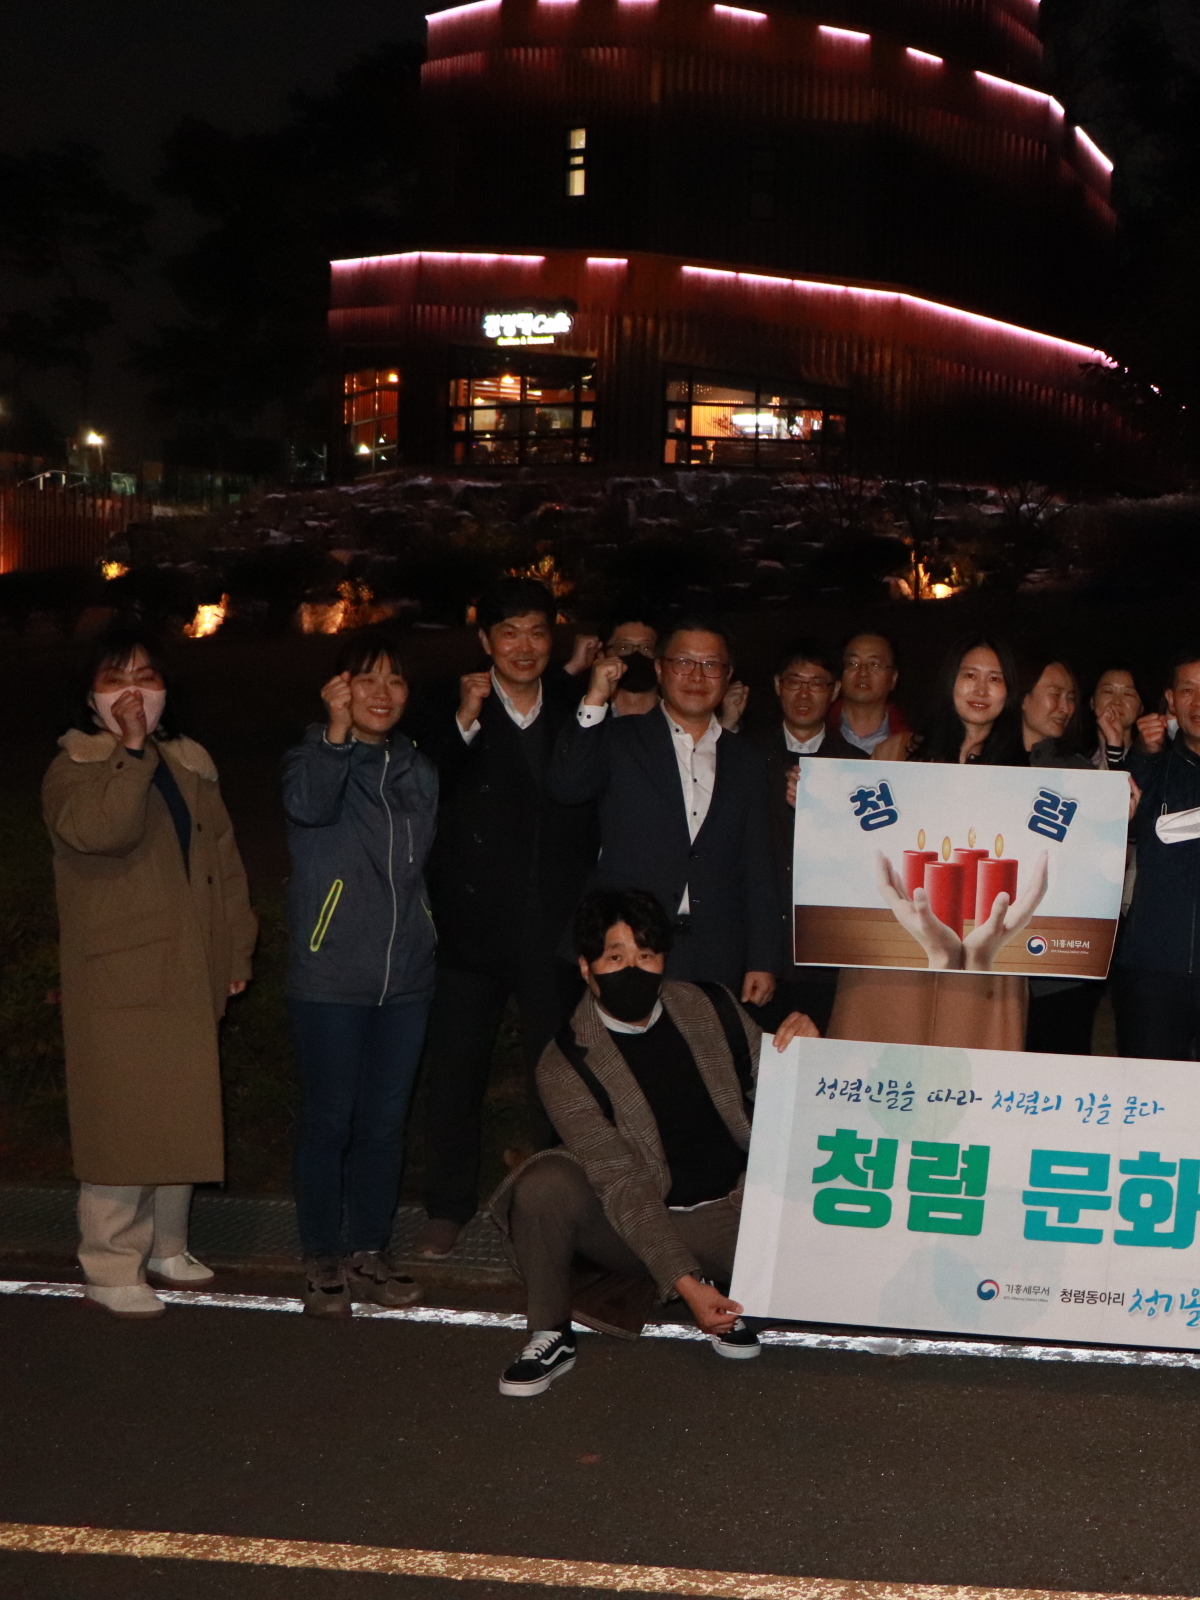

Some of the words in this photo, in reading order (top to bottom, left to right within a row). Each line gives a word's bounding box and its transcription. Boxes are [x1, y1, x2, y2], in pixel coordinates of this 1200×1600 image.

[849, 780, 899, 832] 청
[1027, 788, 1078, 843] 렴
[1050, 939, 1090, 949] 기흥세무서
[816, 1077, 915, 1112] 청렴인물을
[927, 1088, 983, 1105] 따라
[991, 1090, 1062, 1115] 청렴의
[1075, 1092, 1112, 1125] 길을
[1124, 1095, 1165, 1124] 묻다
[812, 1128, 991, 1237] 청렴
[1005, 1284, 1050, 1296] 기흥세무서
[1059, 1288, 1124, 1306] 청렴동아리
